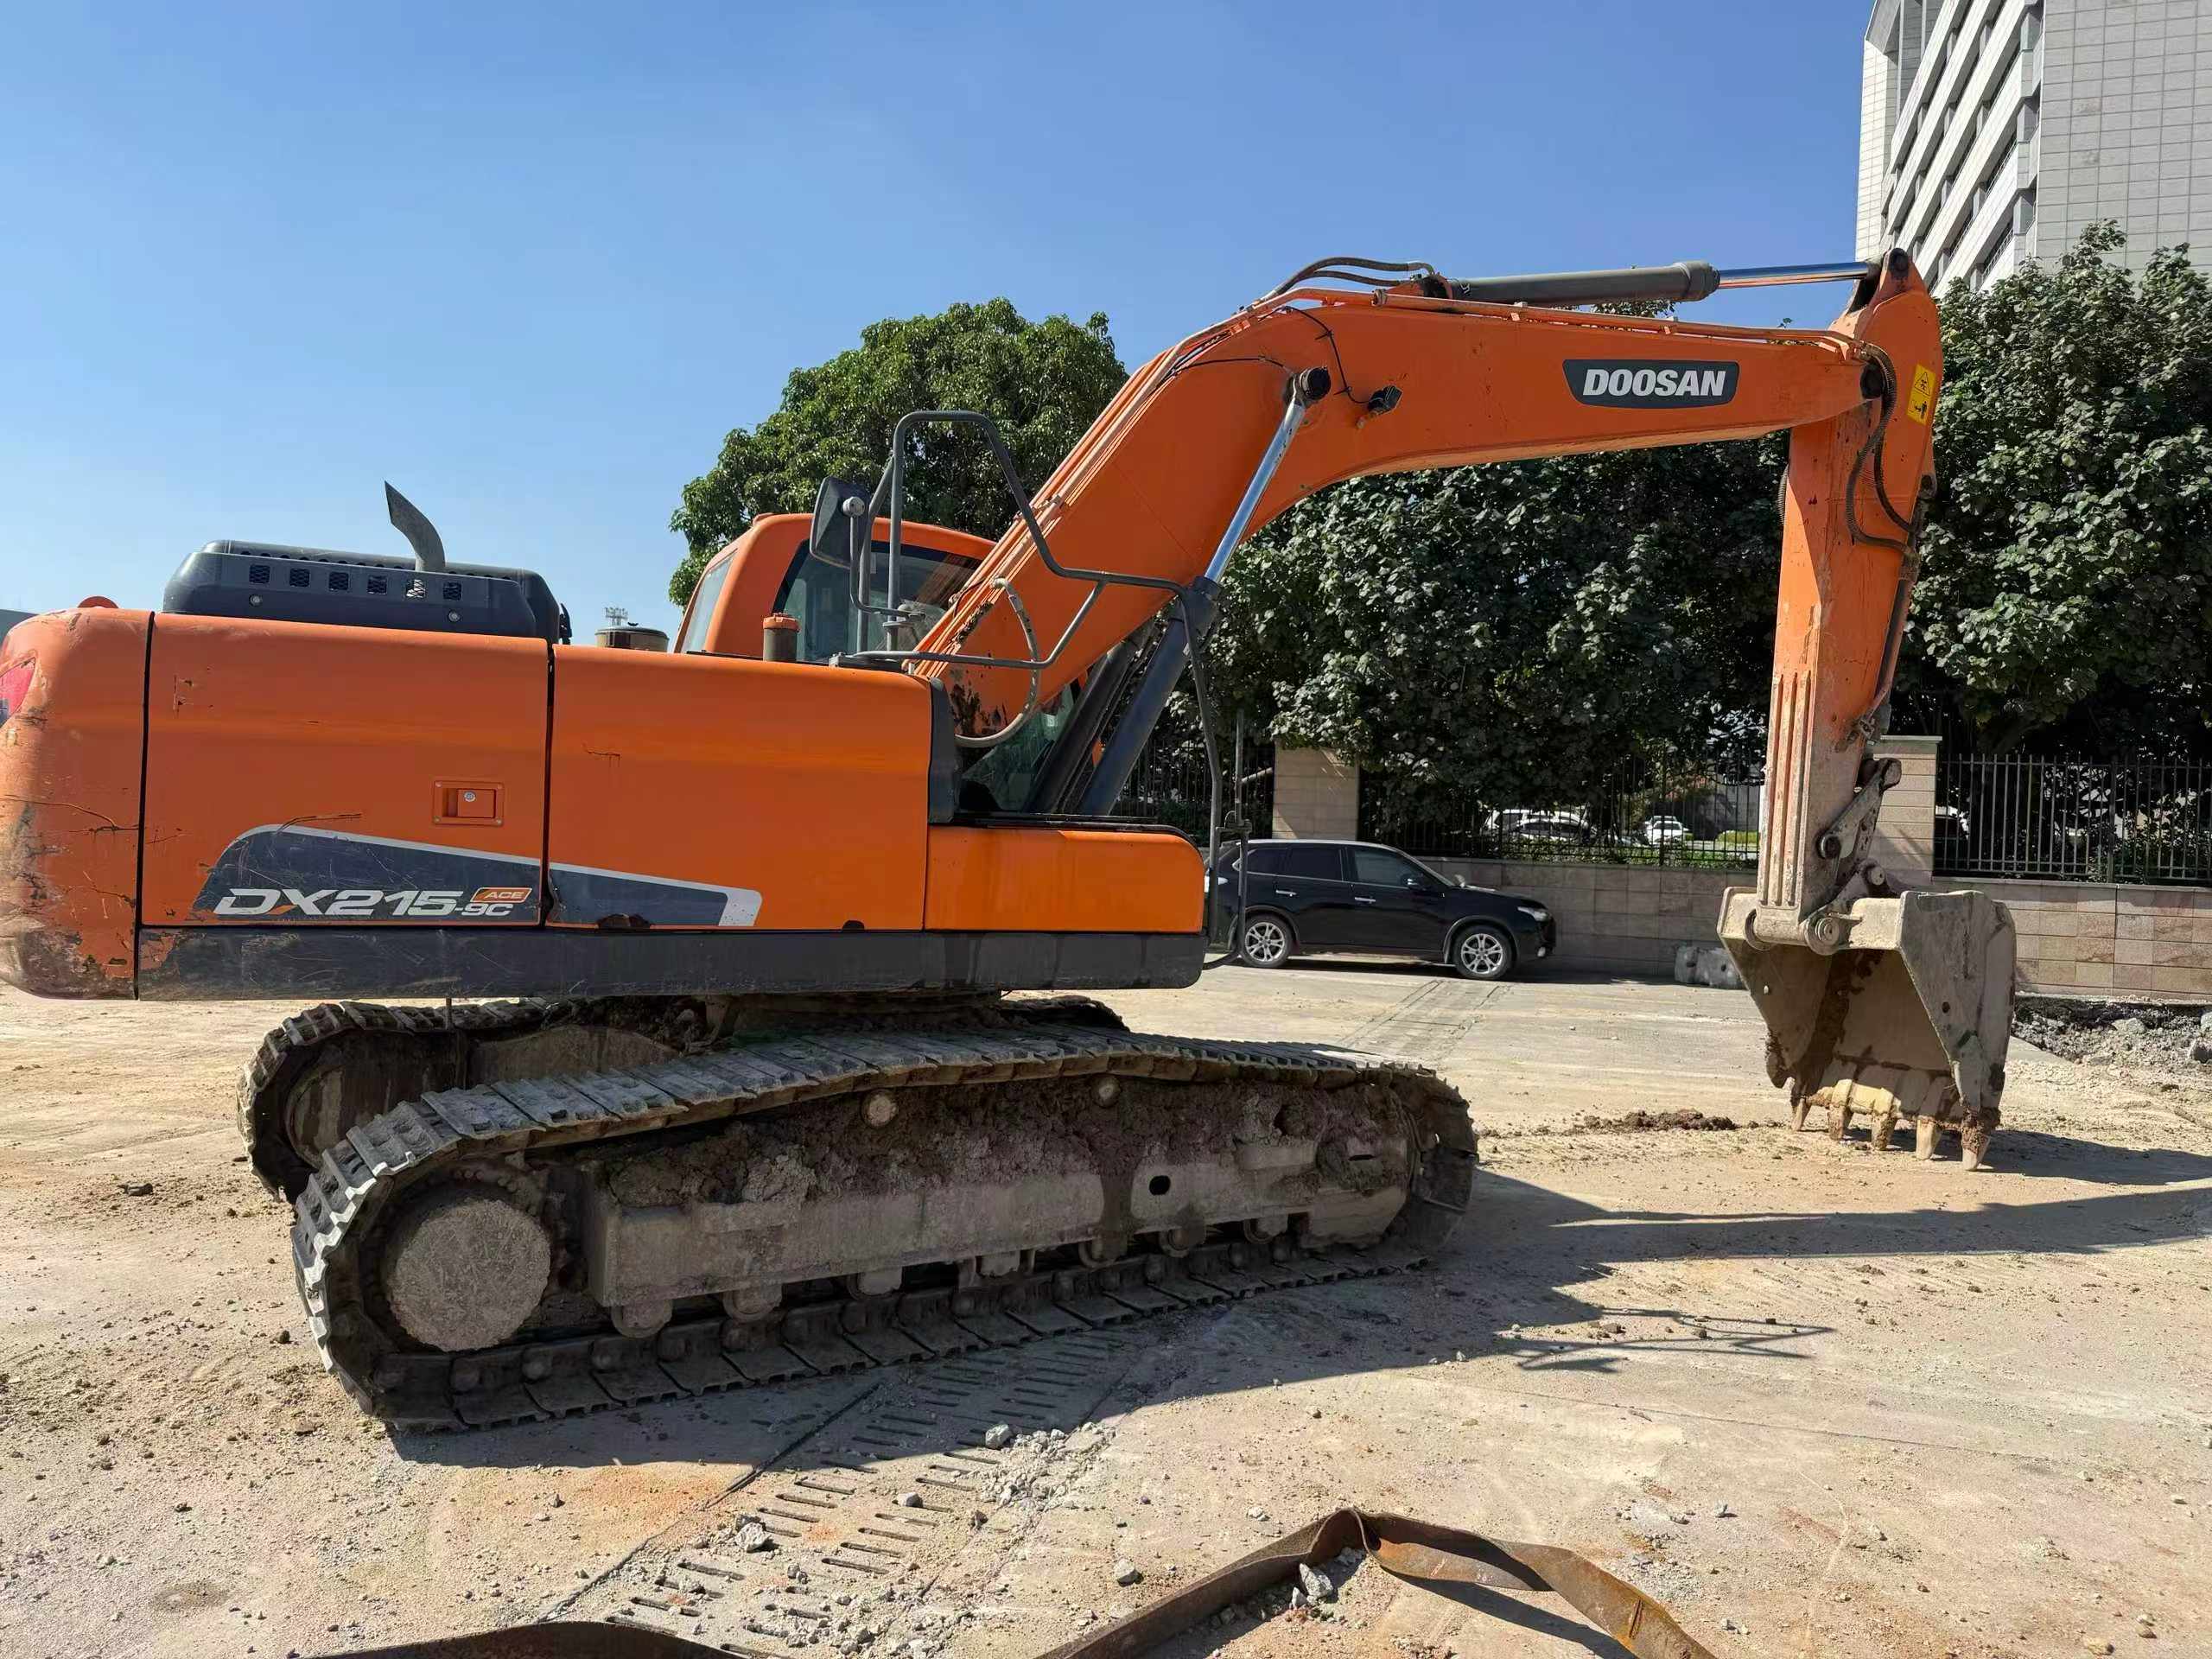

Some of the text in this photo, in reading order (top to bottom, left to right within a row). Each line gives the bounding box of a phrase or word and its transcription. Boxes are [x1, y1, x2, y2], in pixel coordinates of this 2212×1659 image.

[1583, 369, 1726, 397] DOOSAN
[213, 888, 514, 916] DX215-9C
[484, 891, 525, 899] ACE
